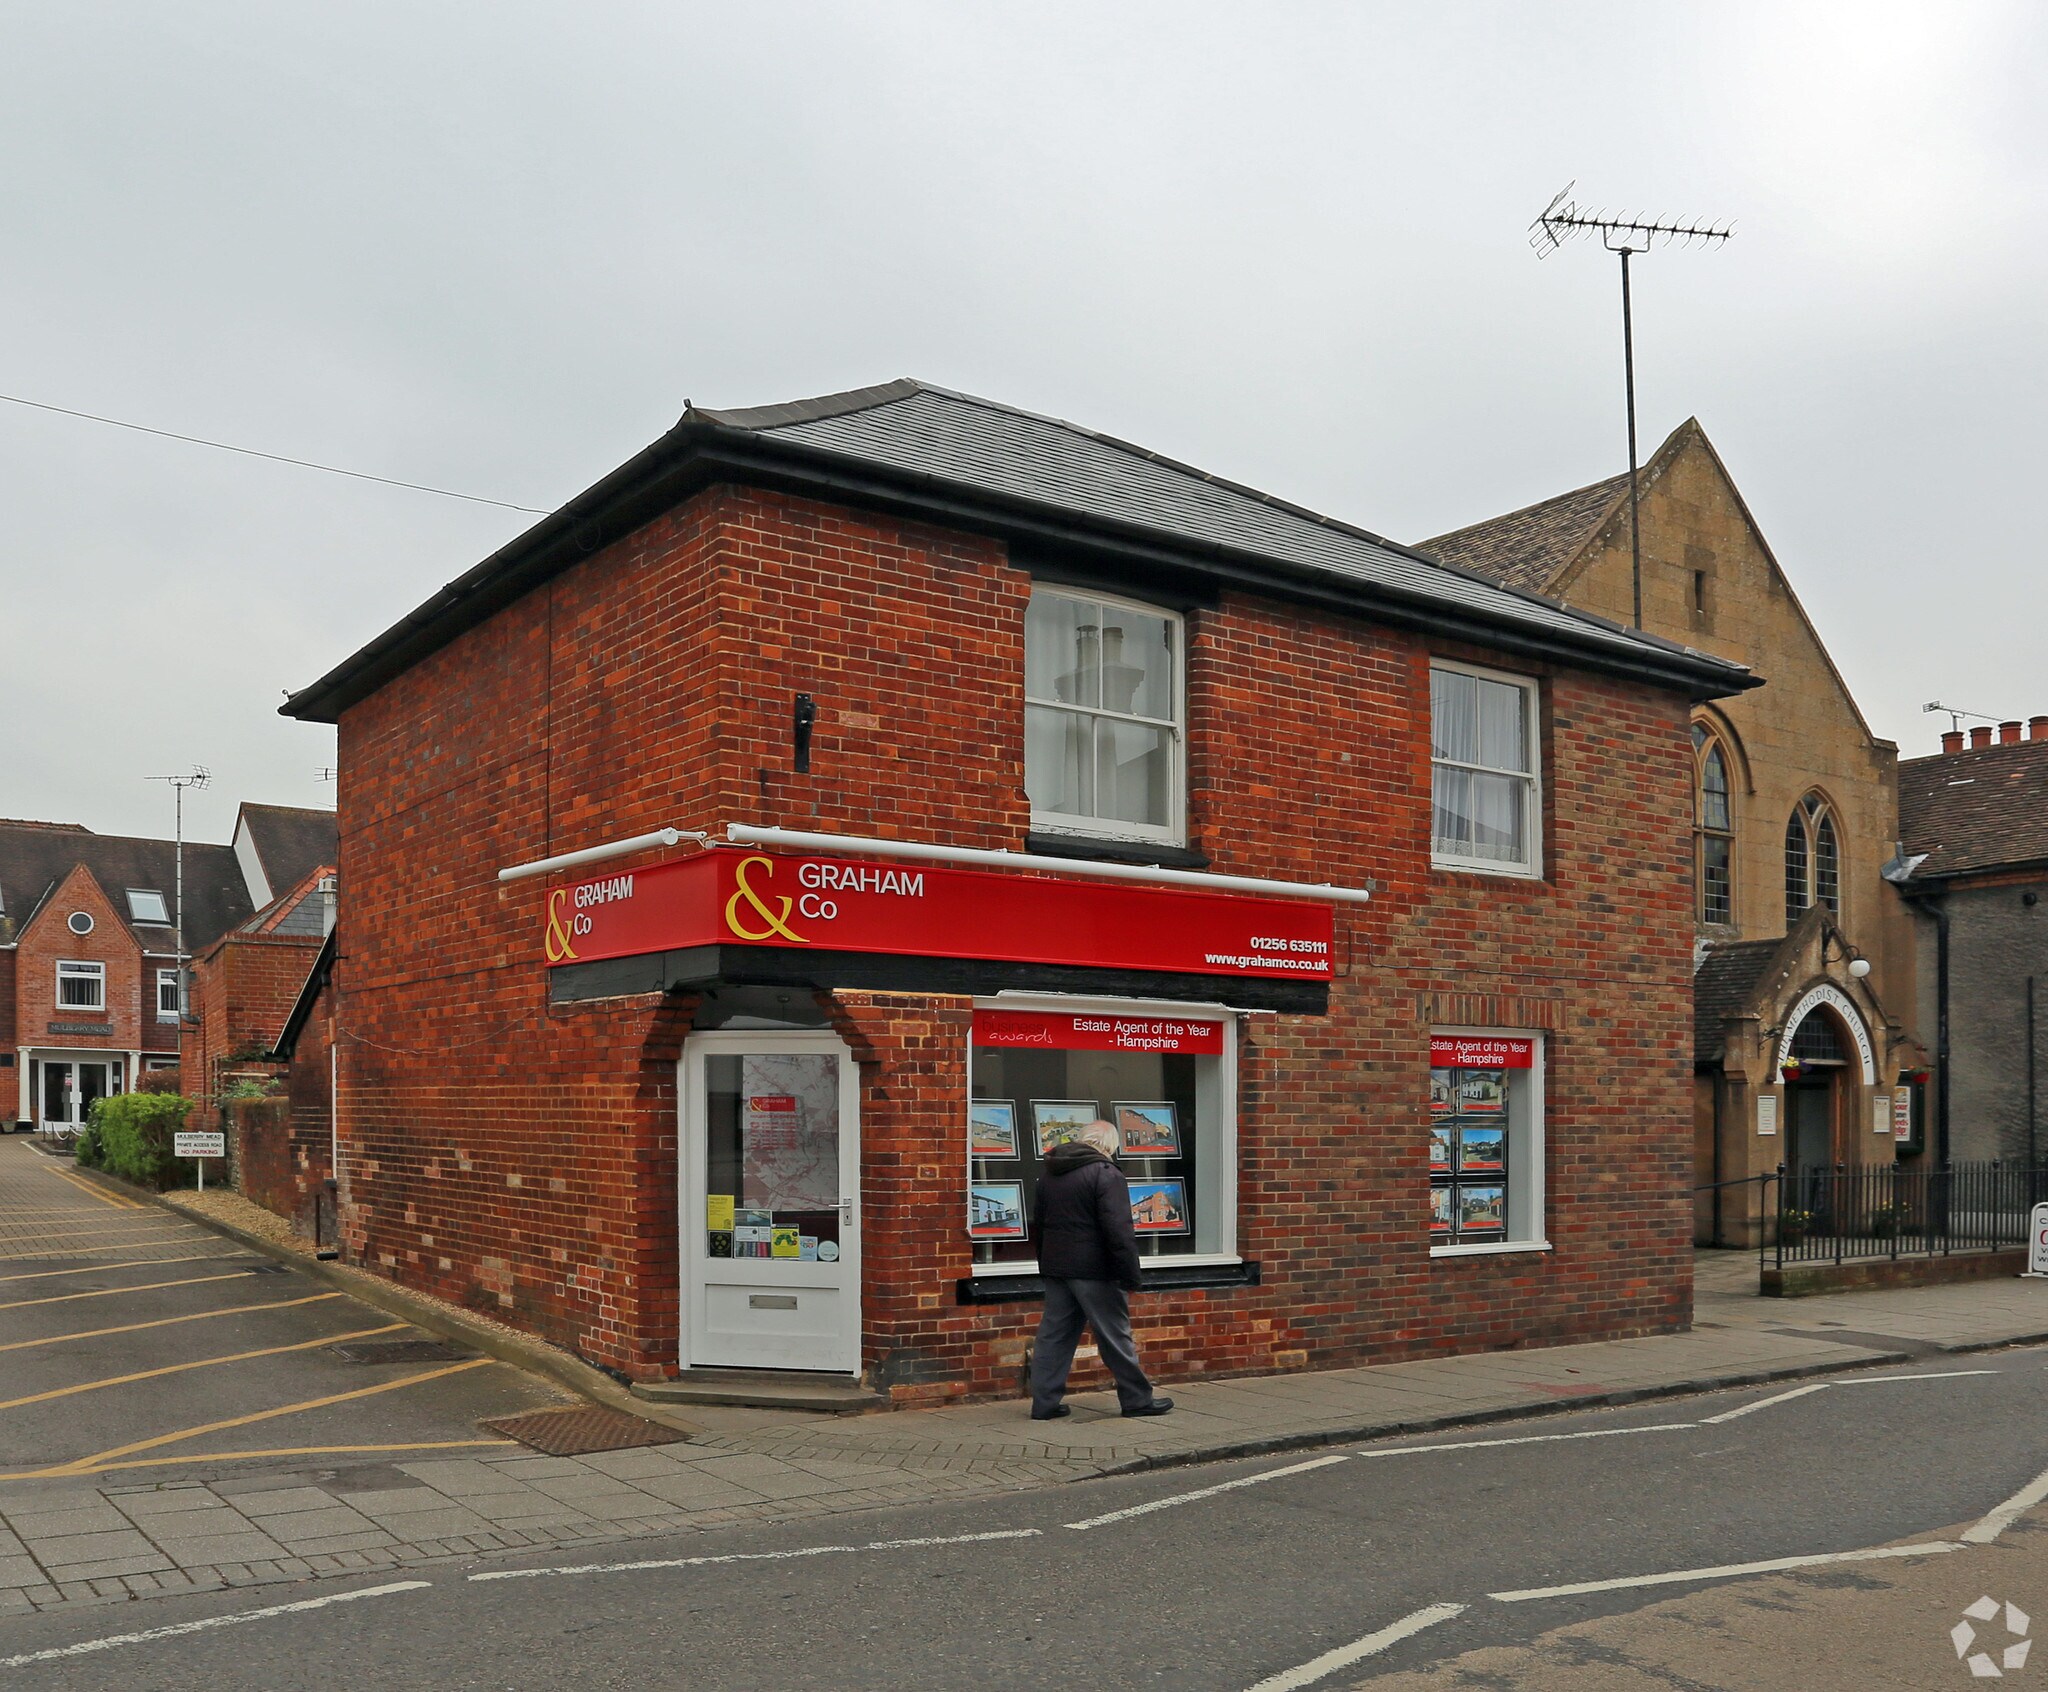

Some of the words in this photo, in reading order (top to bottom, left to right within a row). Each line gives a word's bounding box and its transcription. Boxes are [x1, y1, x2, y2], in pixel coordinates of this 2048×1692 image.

[798, 863, 924, 897] GRAHAM
[574, 874, 633, 908] GRAHAM
[798, 893, 838, 919] Co
[573, 913, 592, 935] Co
[1250, 936, 1287, 951] 01256
[1289, 939, 1327, 954] 635111
[1204, 953, 1329, 971] www.grahamco.co.uk
[1073, 1018, 1111, 1032] Estate
[1113, 1020, 1148, 1036] Agent
[1151, 1022, 1163, 1034] of
[1165, 1023, 1184, 1035] the
[1186, 1024, 1211, 1037] Year
[1786, 988, 1840, 1031] METHODIST
[1842, 1004, 1871, 1064] CHURCH
[989, 1028, 1053, 1044] awards
[1117, 1034, 1179, 1050] Hampshire
[1430, 1040, 1453, 1051] state
[1455, 1041, 1481, 1053] Agent
[1483, 1042, 1492, 1052] of
[1493, 1042, 1508, 1053] the
[1510, 1042, 1528, 1053] Year
[1457, 1053, 1504, 1066] Hampshire
